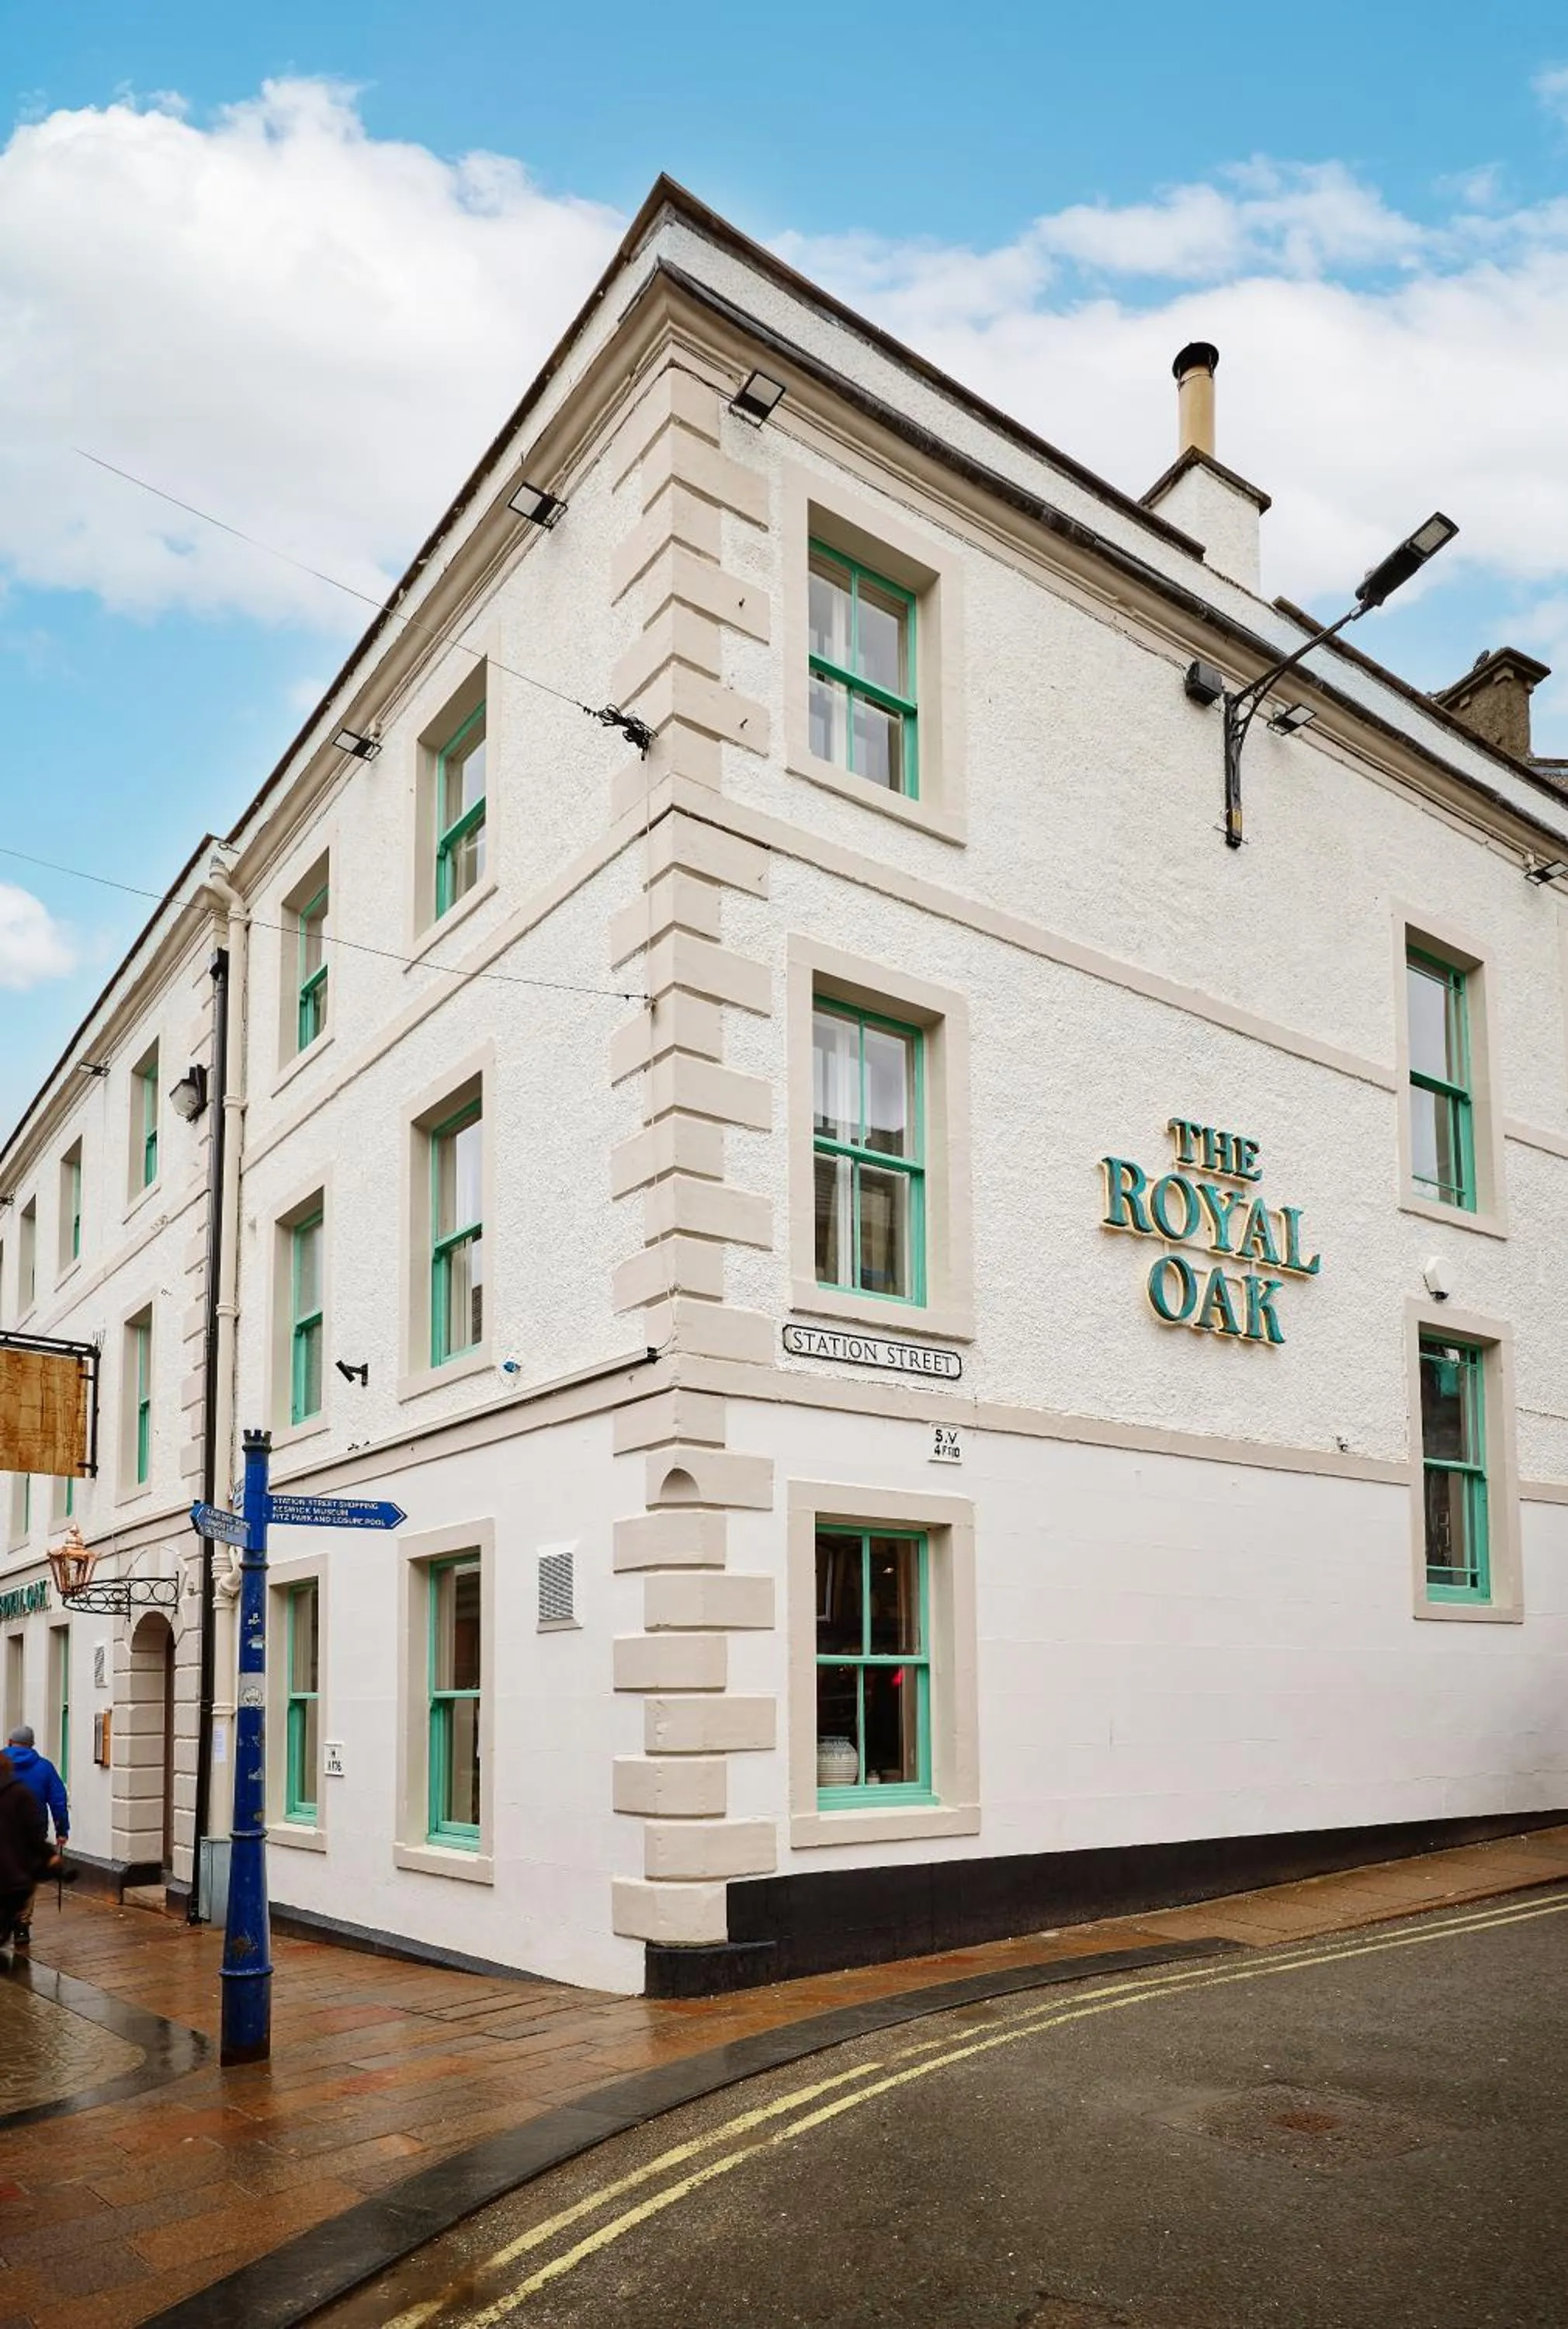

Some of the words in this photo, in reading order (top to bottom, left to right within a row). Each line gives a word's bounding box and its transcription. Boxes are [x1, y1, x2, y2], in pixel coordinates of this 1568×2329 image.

[1167, 1117, 1264, 1182] THE
[1100, 1156, 1320, 1275] ROYAL
[1147, 1254, 1285, 1344] OAK
[793, 1331, 878, 1362] STATION
[887, 1346, 952, 1373] STREET
[272, 1496, 306, 1505] STATION
[308, 1498, 337, 1507] STREET
[339, 1501, 379, 1510] SHOPPING
[314, 1507, 349, 1516] MUSEUM
[364, 1518, 386, 1526] POOL
